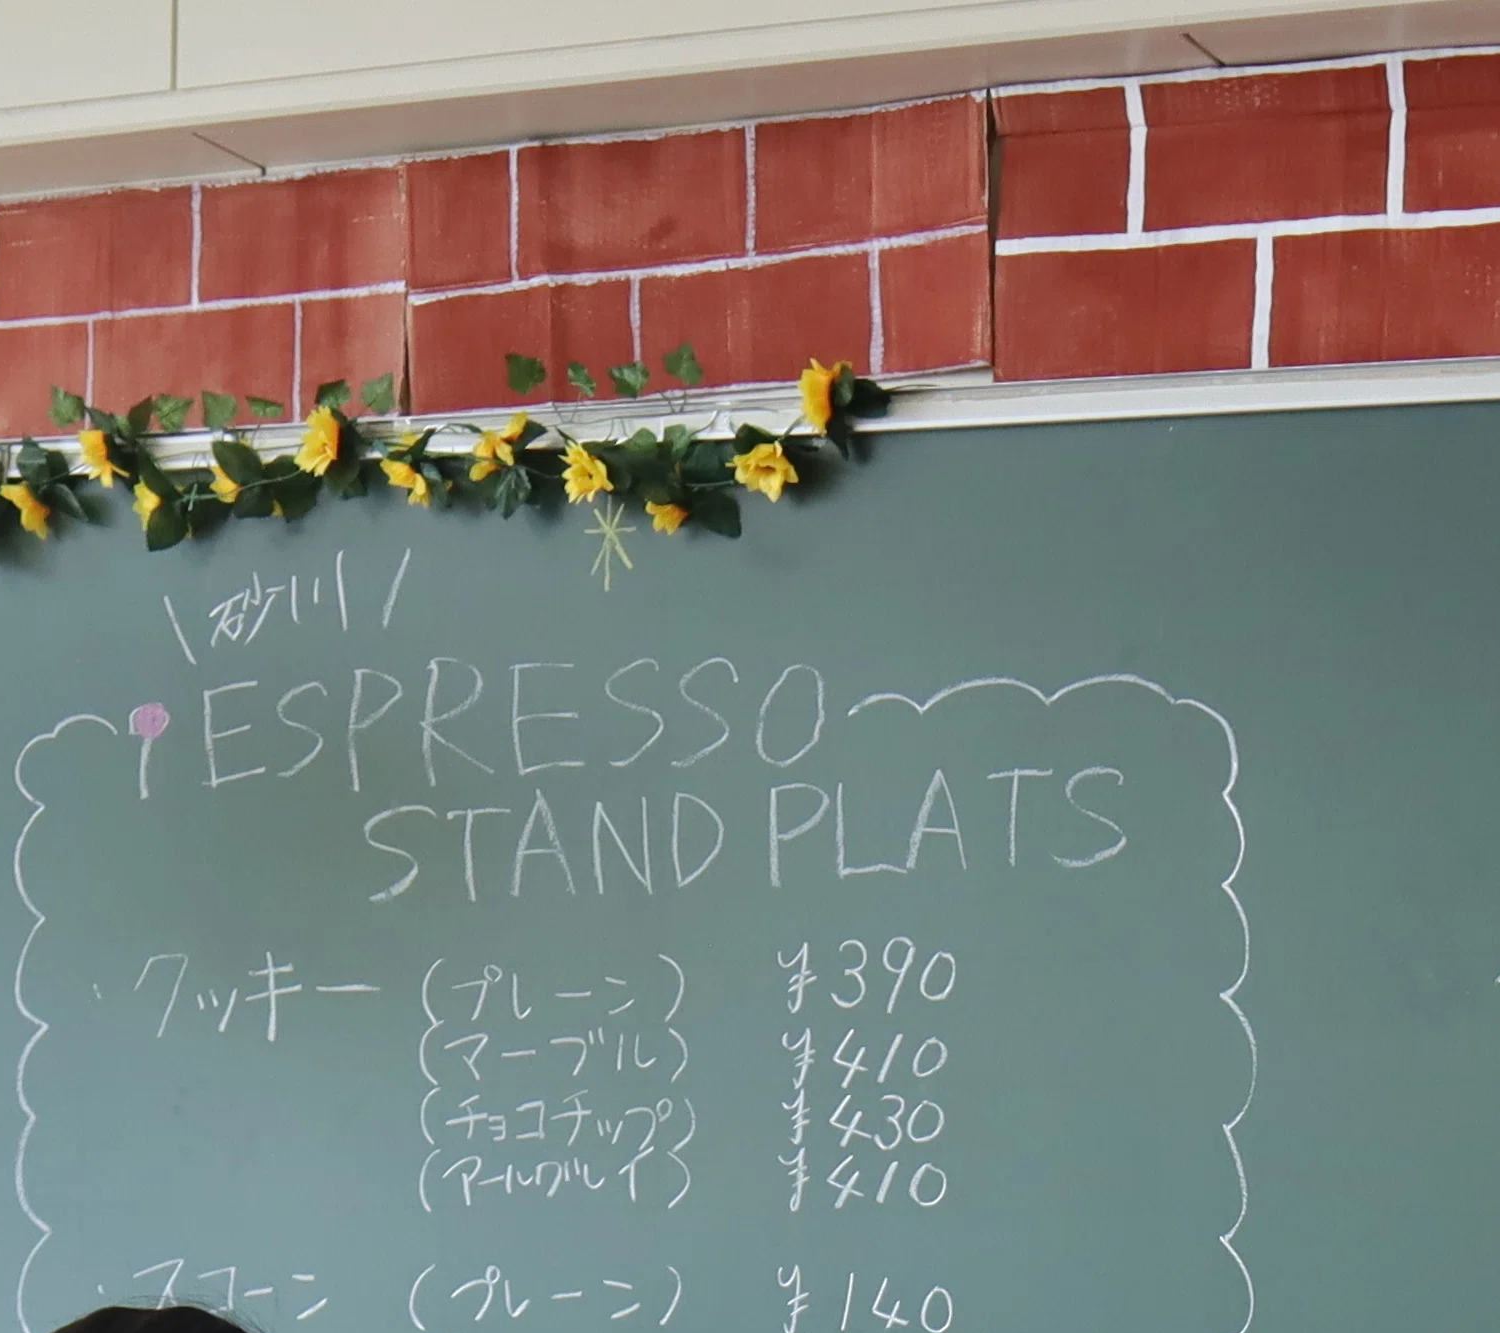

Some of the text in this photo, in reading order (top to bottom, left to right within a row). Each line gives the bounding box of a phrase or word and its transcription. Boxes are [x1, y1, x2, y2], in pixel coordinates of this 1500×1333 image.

[202, 657, 826, 791] ESPRESSO
[364, 766, 1127, 902] STAND PLATS
[778, 937, 956, 1013] ¥390
[782, 1028, 948, 1088] ¥410
[781, 1088, 945, 1150] ¥430
[778, 1148, 948, 1212] ¥410
